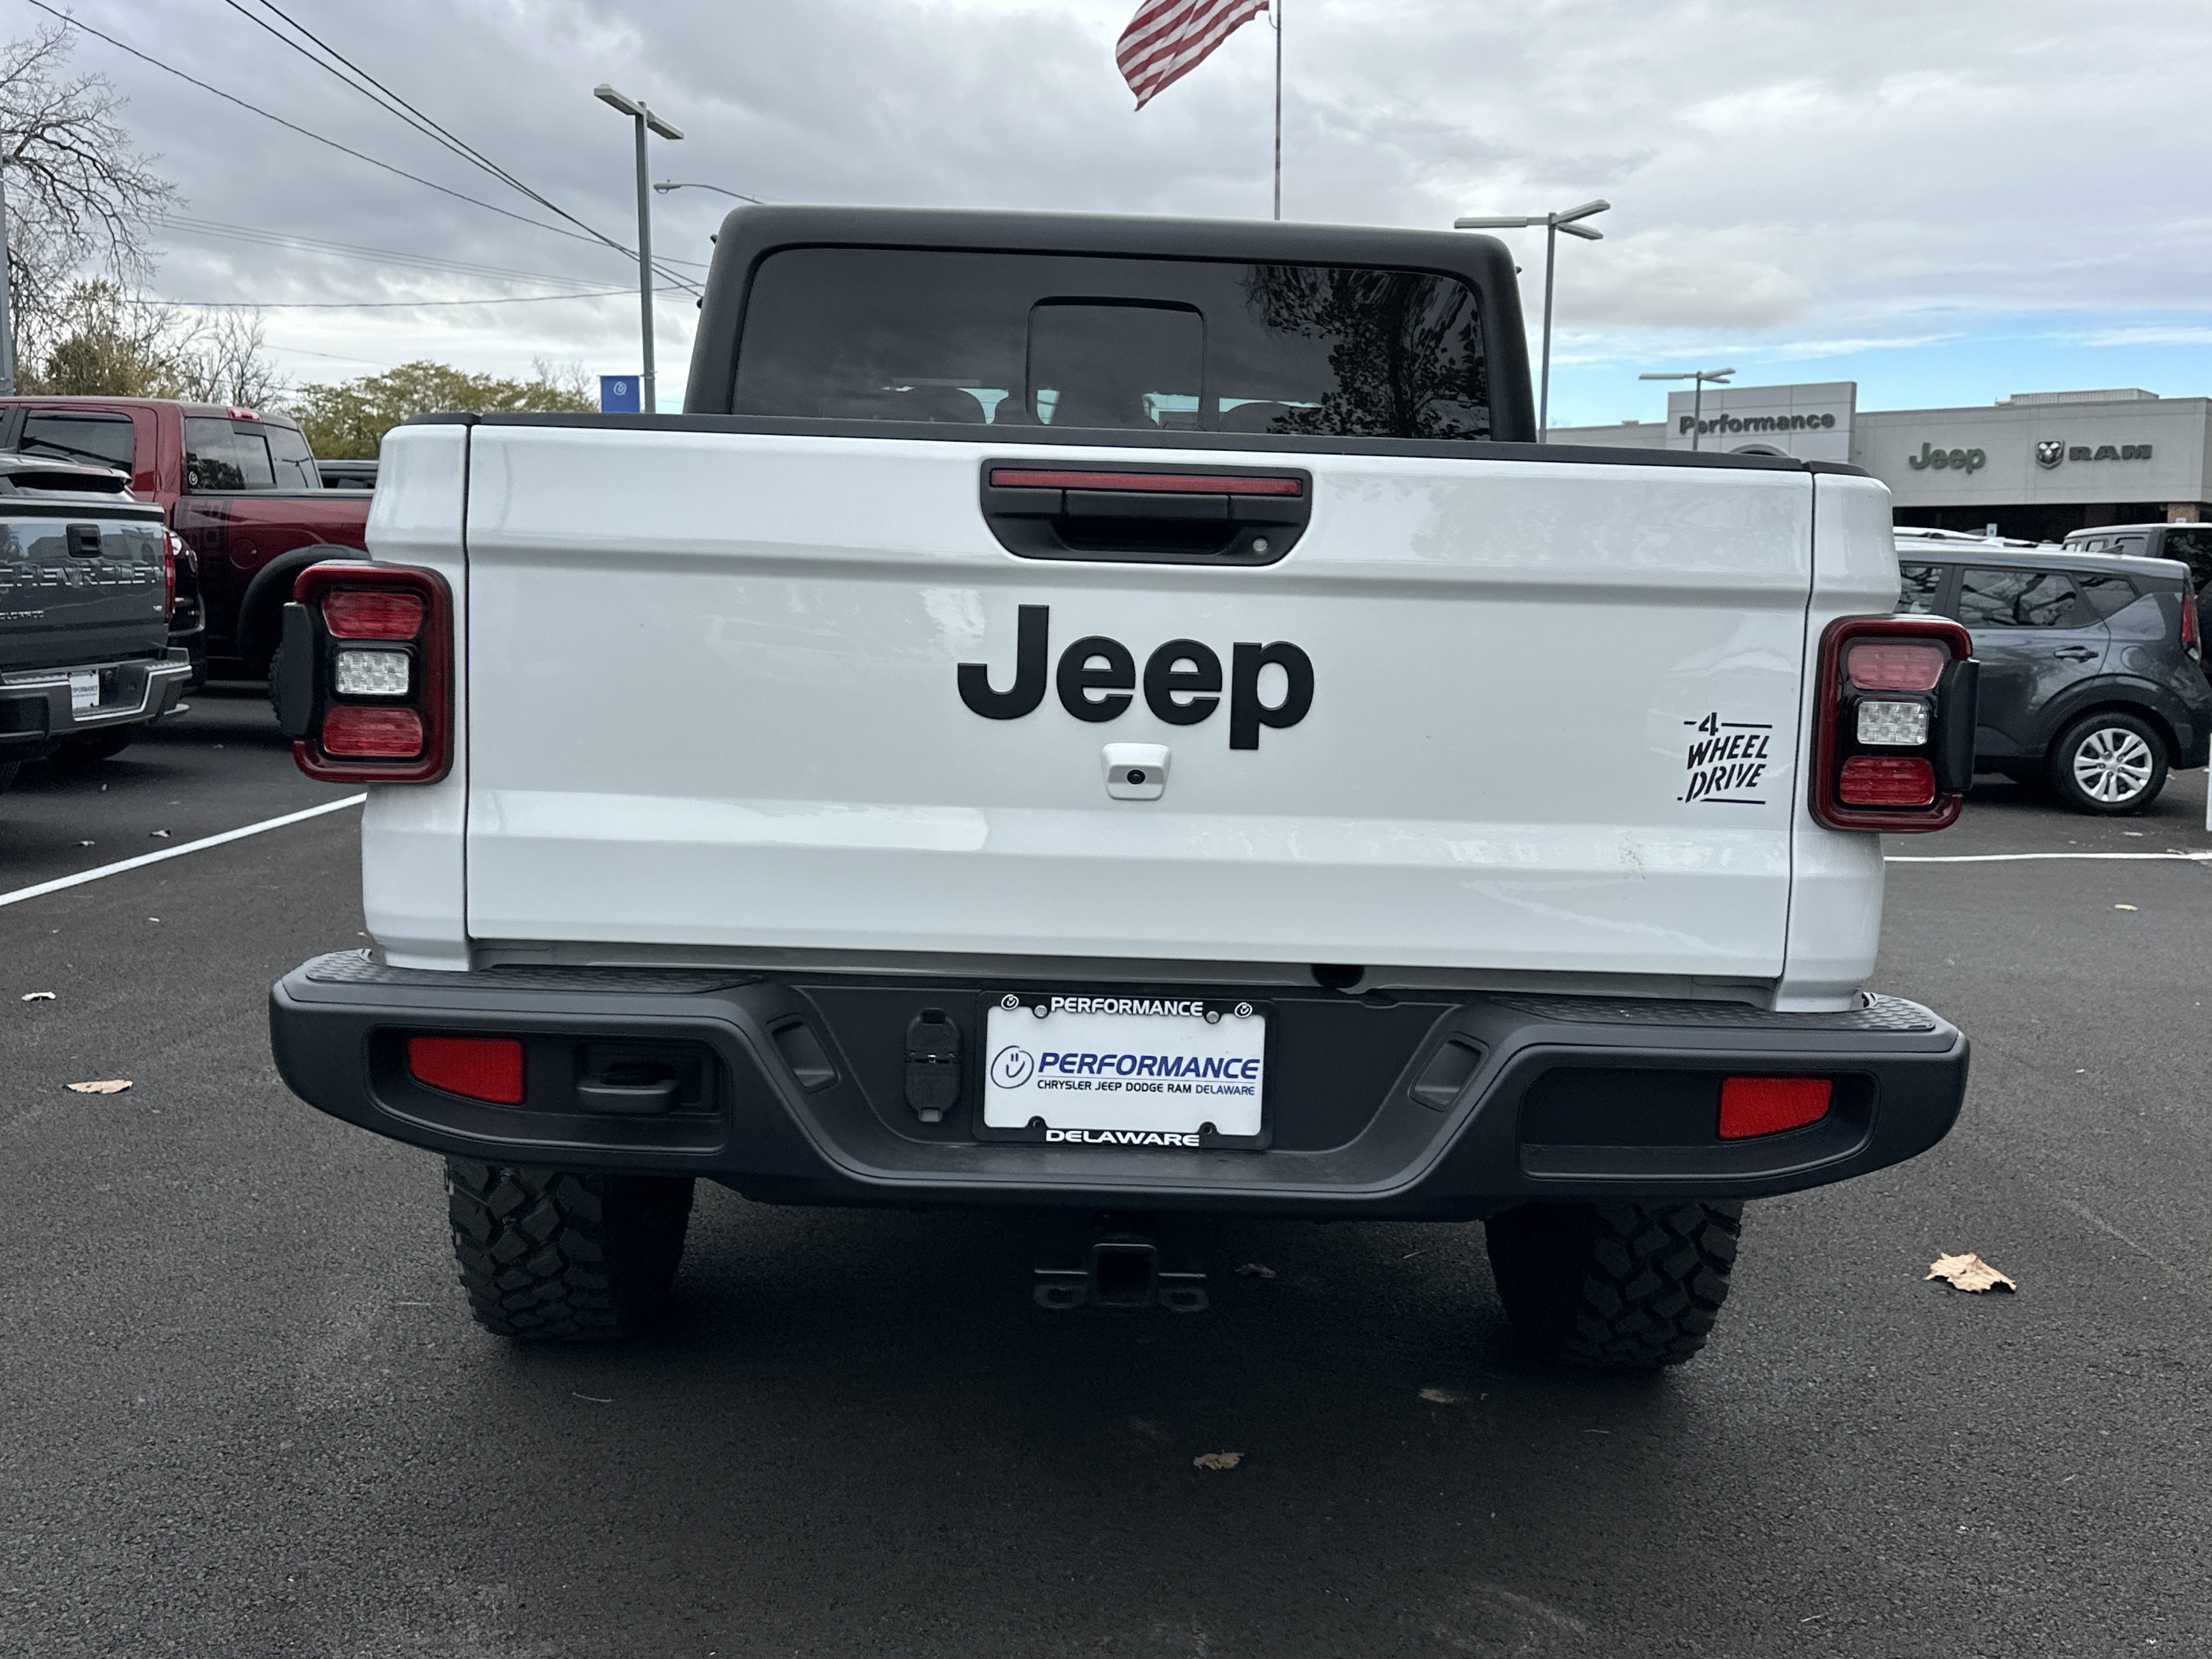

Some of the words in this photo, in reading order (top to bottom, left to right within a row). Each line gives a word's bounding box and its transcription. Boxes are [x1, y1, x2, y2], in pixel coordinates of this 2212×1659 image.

[1679, 413, 1836, 435] Performance
[1909, 442, 1987, 474] Jeep
[2069, 444, 2153, 461] RAM
[957, 603, 1315, 751] Jeep
[1698, 712, 1719, 736] 4
[1687, 735, 1770, 770] WHEEL
[1685, 763, 1767, 803] DRIVE
[1051, 996, 1204, 1017] PERFORMANCE
[1037, 1052, 1261, 1080] PERFORMANCE
[1037, 1079, 1092, 1091] CHRYSLER
[1094, 1081, 1122, 1092] JEEP
[1125, 1082, 1164, 1093] DODGE
[1167, 1084, 1192, 1094] RAM
[1195, 1085, 1255, 1096] DELAWARE
[1045, 1130, 1200, 1147] DELAWARE
